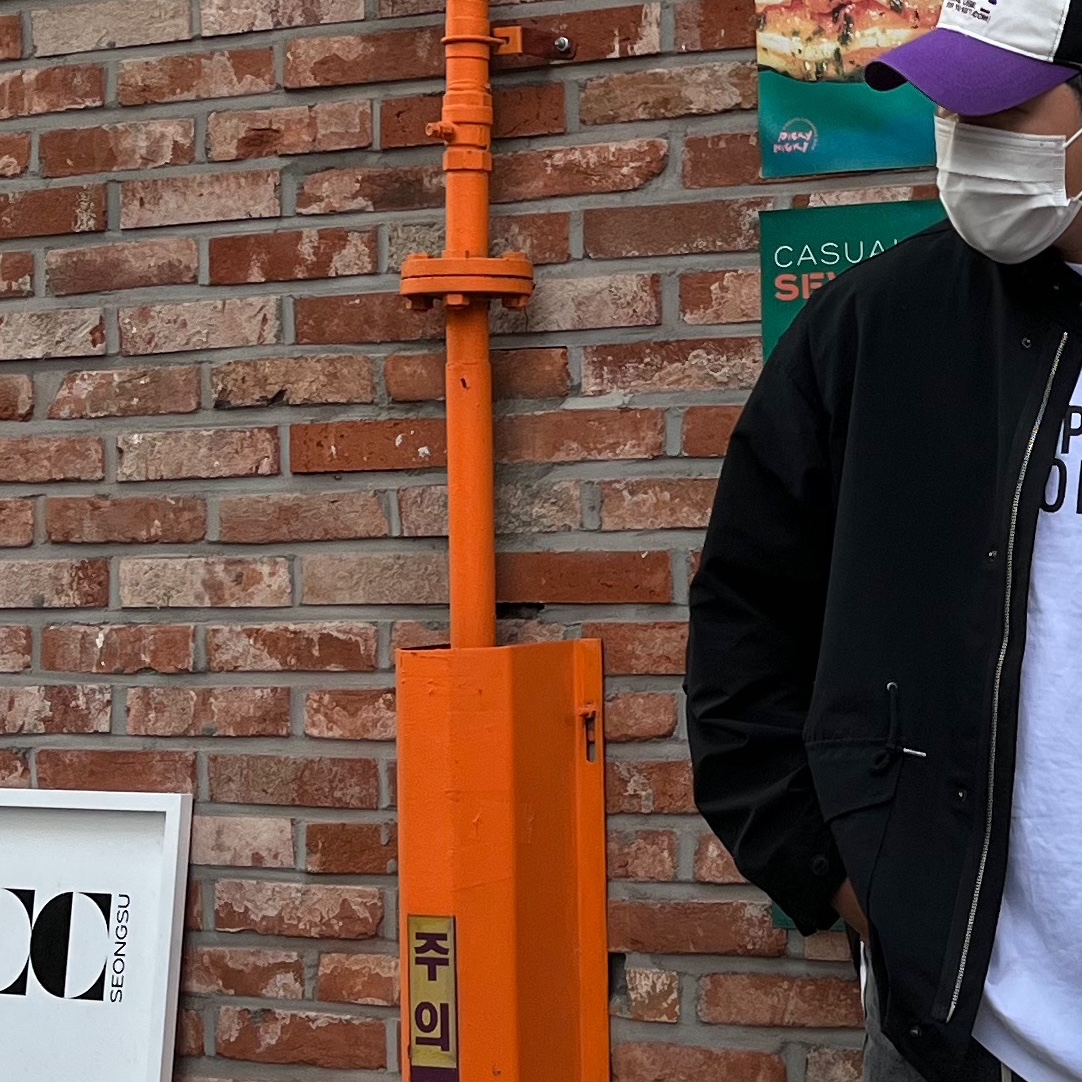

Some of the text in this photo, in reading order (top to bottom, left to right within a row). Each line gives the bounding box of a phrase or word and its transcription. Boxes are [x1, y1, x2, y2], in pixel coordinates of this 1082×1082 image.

[774, 239, 898, 268] CASUA
[110, 893, 131, 1003] SEONGSU
[414, 932, 450, 1052] 주의
